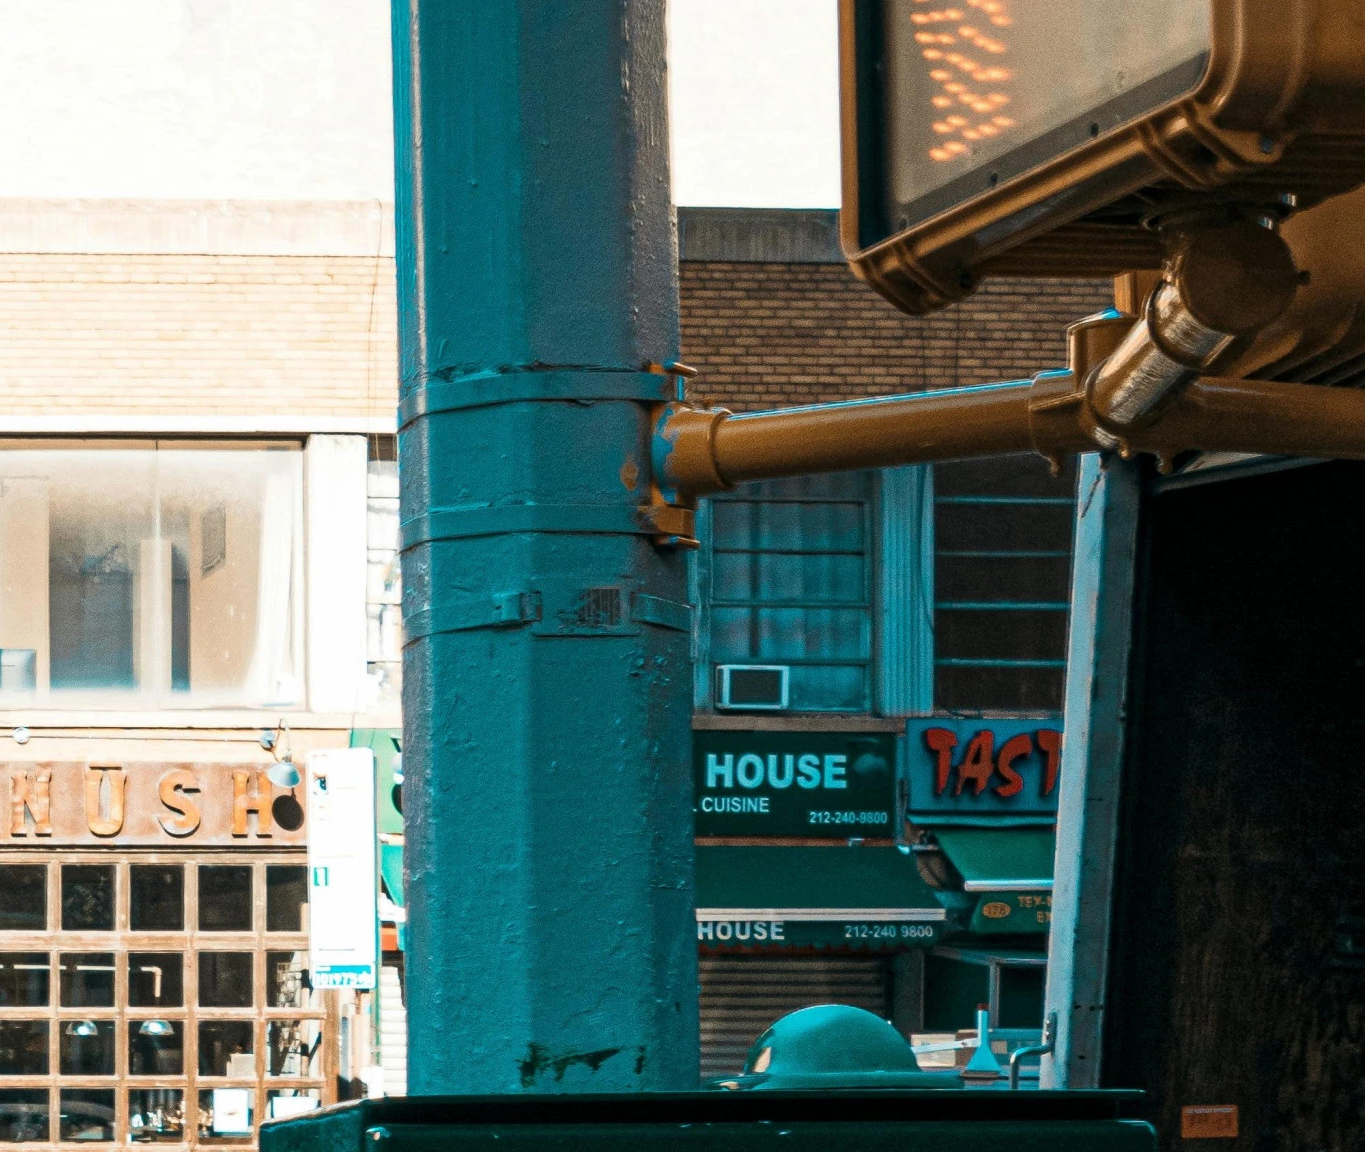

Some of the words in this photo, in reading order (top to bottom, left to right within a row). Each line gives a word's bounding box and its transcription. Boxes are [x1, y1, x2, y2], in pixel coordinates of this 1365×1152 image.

[706, 753, 847, 789] HOUSE
[701, 797, 769, 813] CUISINE
[808, 811, 888, 824] 212-240-9800
[697, 921, 785, 941] HOUSE
